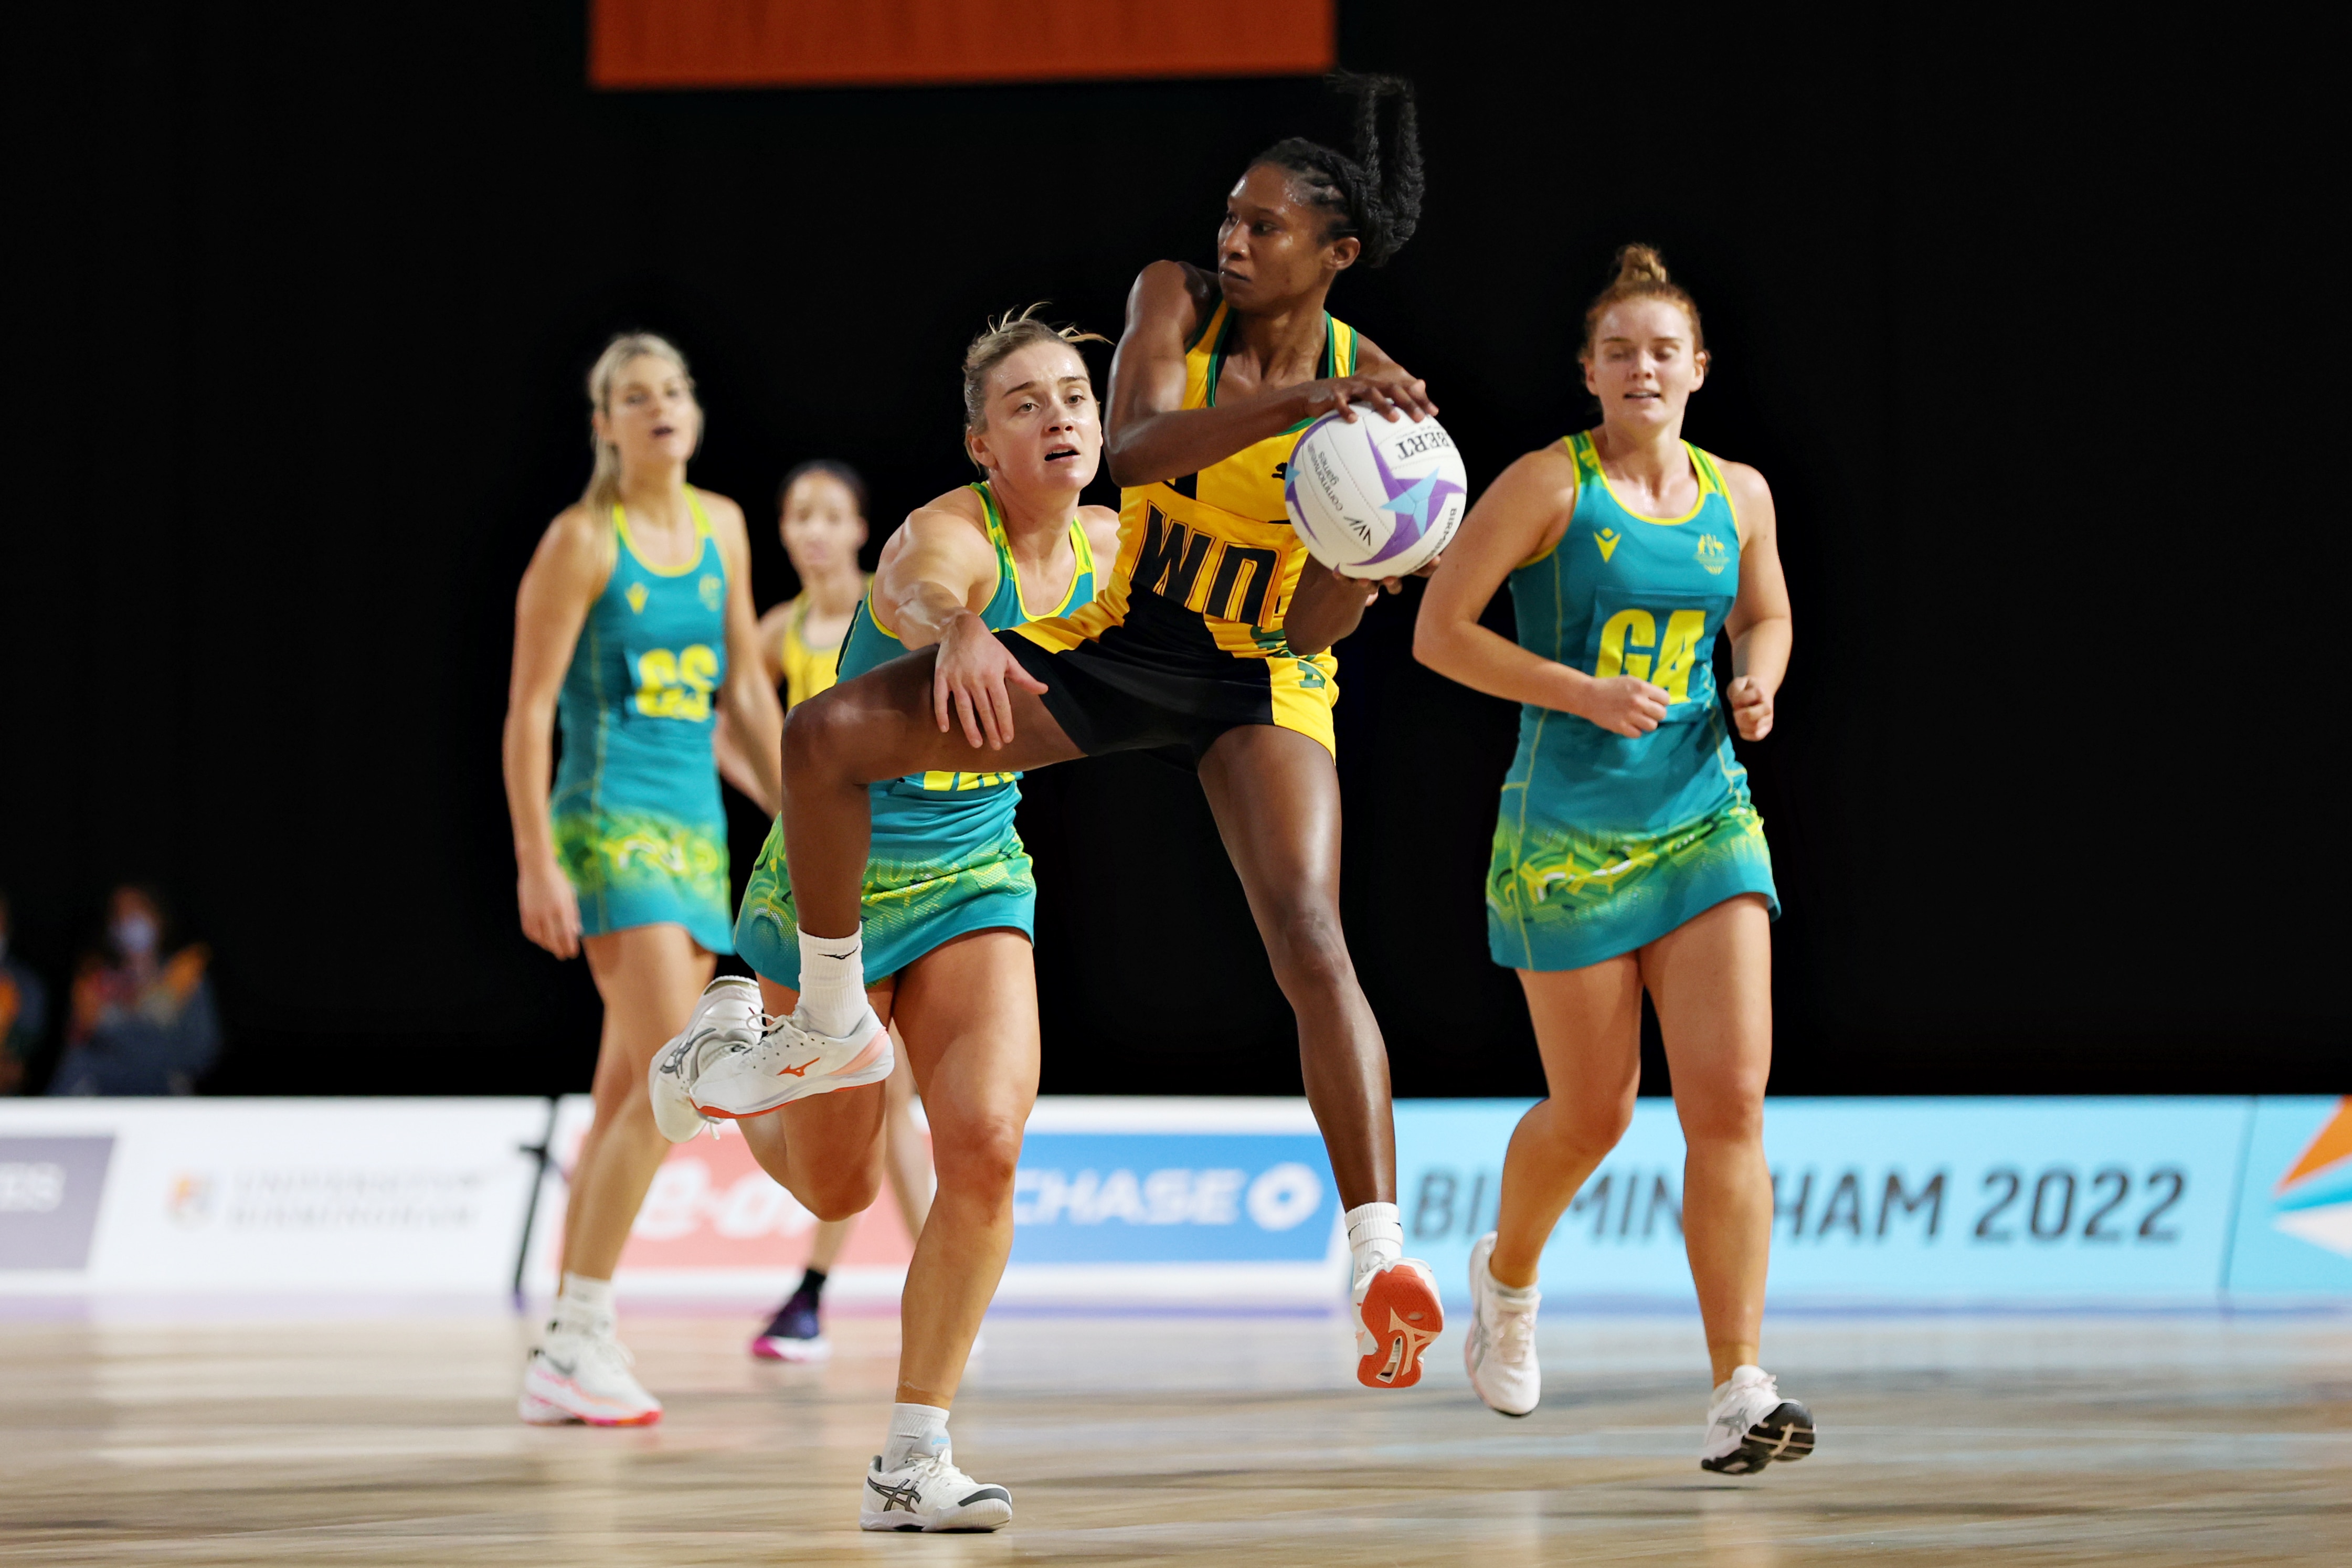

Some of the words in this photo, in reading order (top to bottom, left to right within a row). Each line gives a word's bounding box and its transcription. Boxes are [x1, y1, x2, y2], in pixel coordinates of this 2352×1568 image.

[1318, 451, 1339, 486] games
[1395, 431, 1452, 461] BERT
[635, 643, 719, 722] GS
[1595, 608, 1706, 705] GA
[1013, 1167, 1246, 1226] CHASE
[1413, 1168, 1946, 1241] BIMINHAM
[1974, 1167, 2186, 1241] 2022
